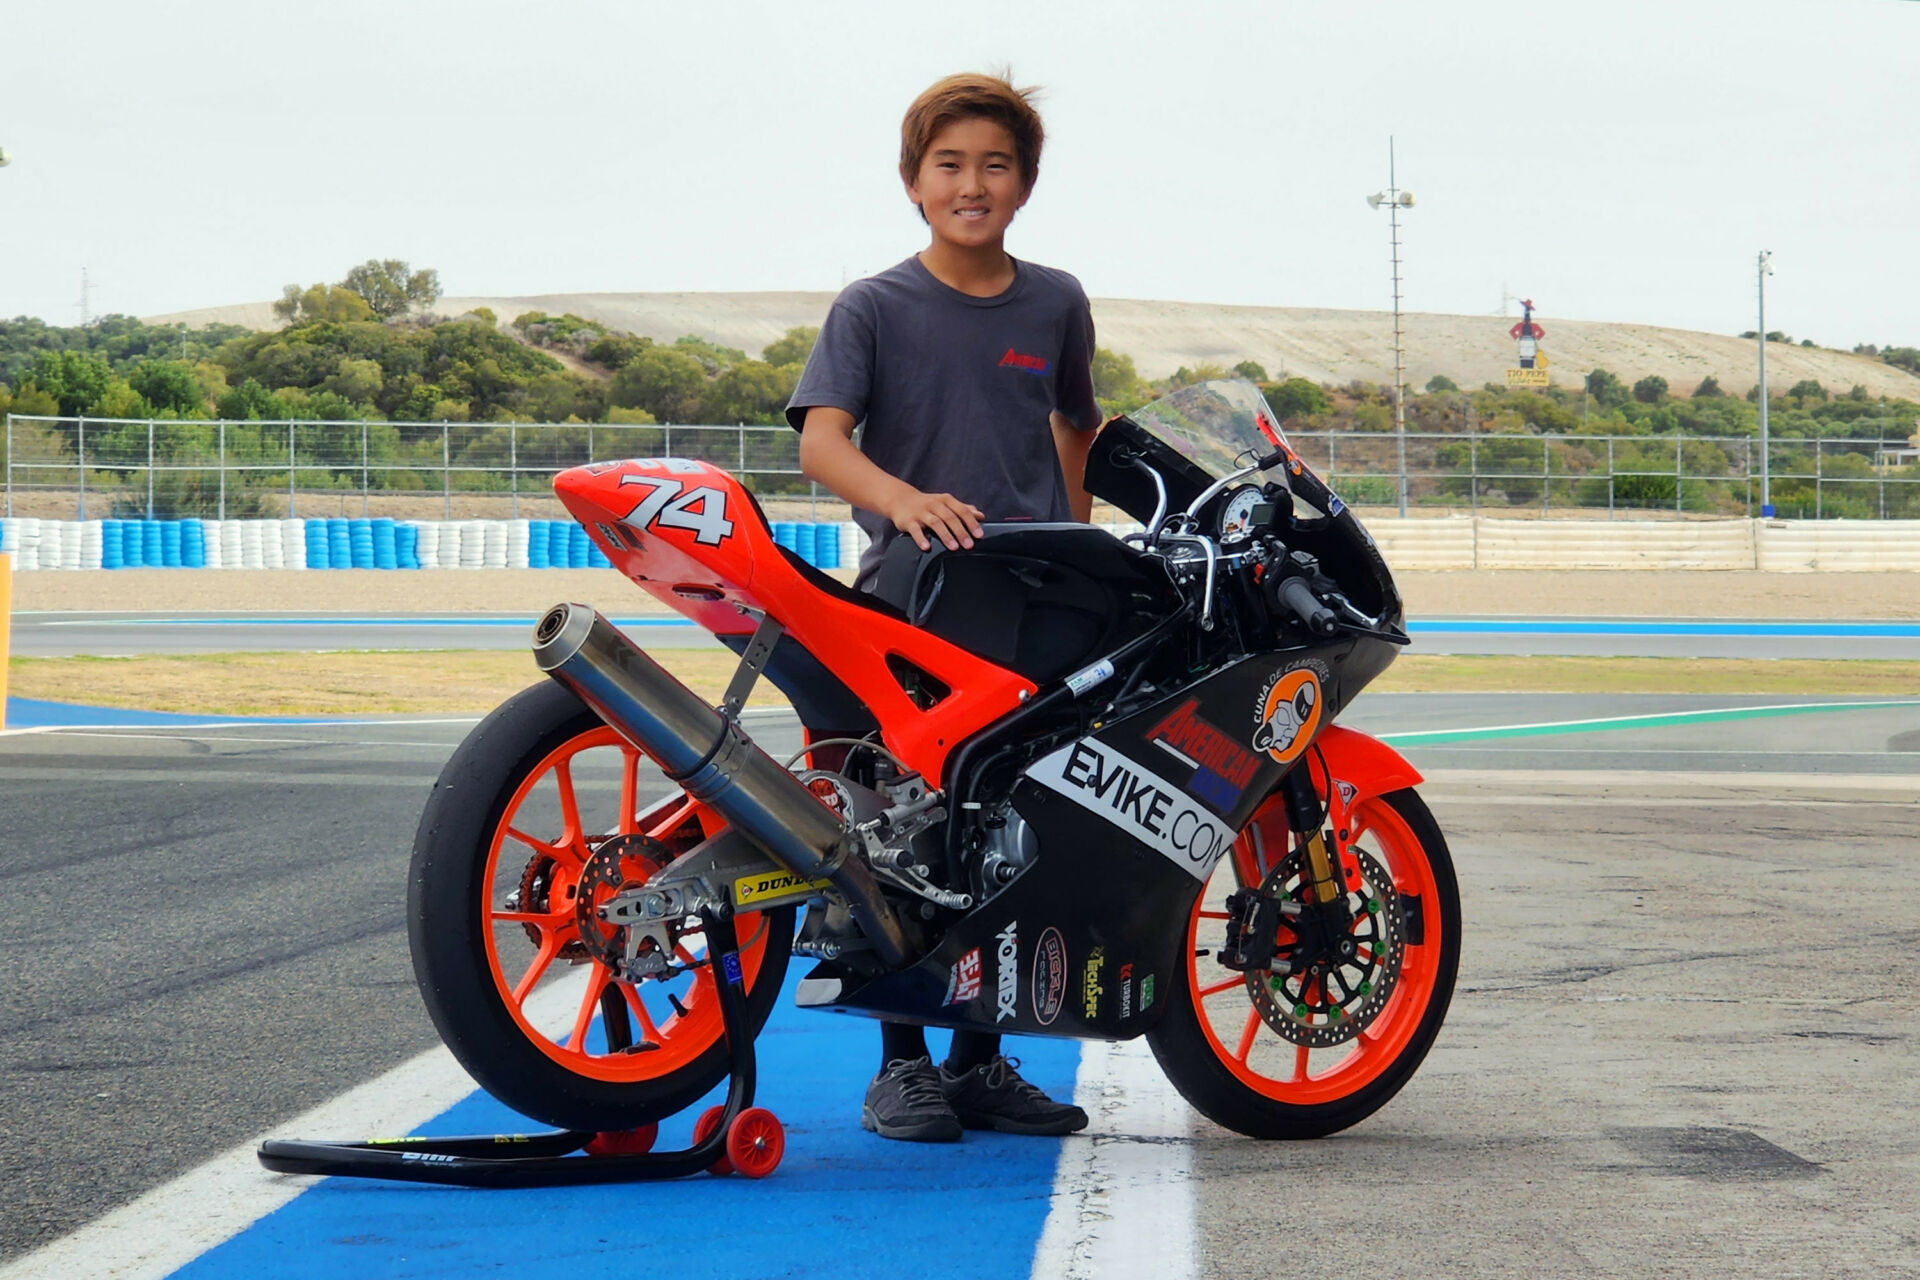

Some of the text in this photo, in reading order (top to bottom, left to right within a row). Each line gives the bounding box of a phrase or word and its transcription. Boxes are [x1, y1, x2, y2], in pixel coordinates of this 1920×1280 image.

[618, 473, 735, 548] 74
[1253, 684, 1270, 724] CUNA
[1269, 667, 1283, 685] DE
[1145, 700, 1261, 790] AMERICAN
[995, 920, 1018, 1024] VORTEX
[1044, 936, 1061, 1014] BICKLE
